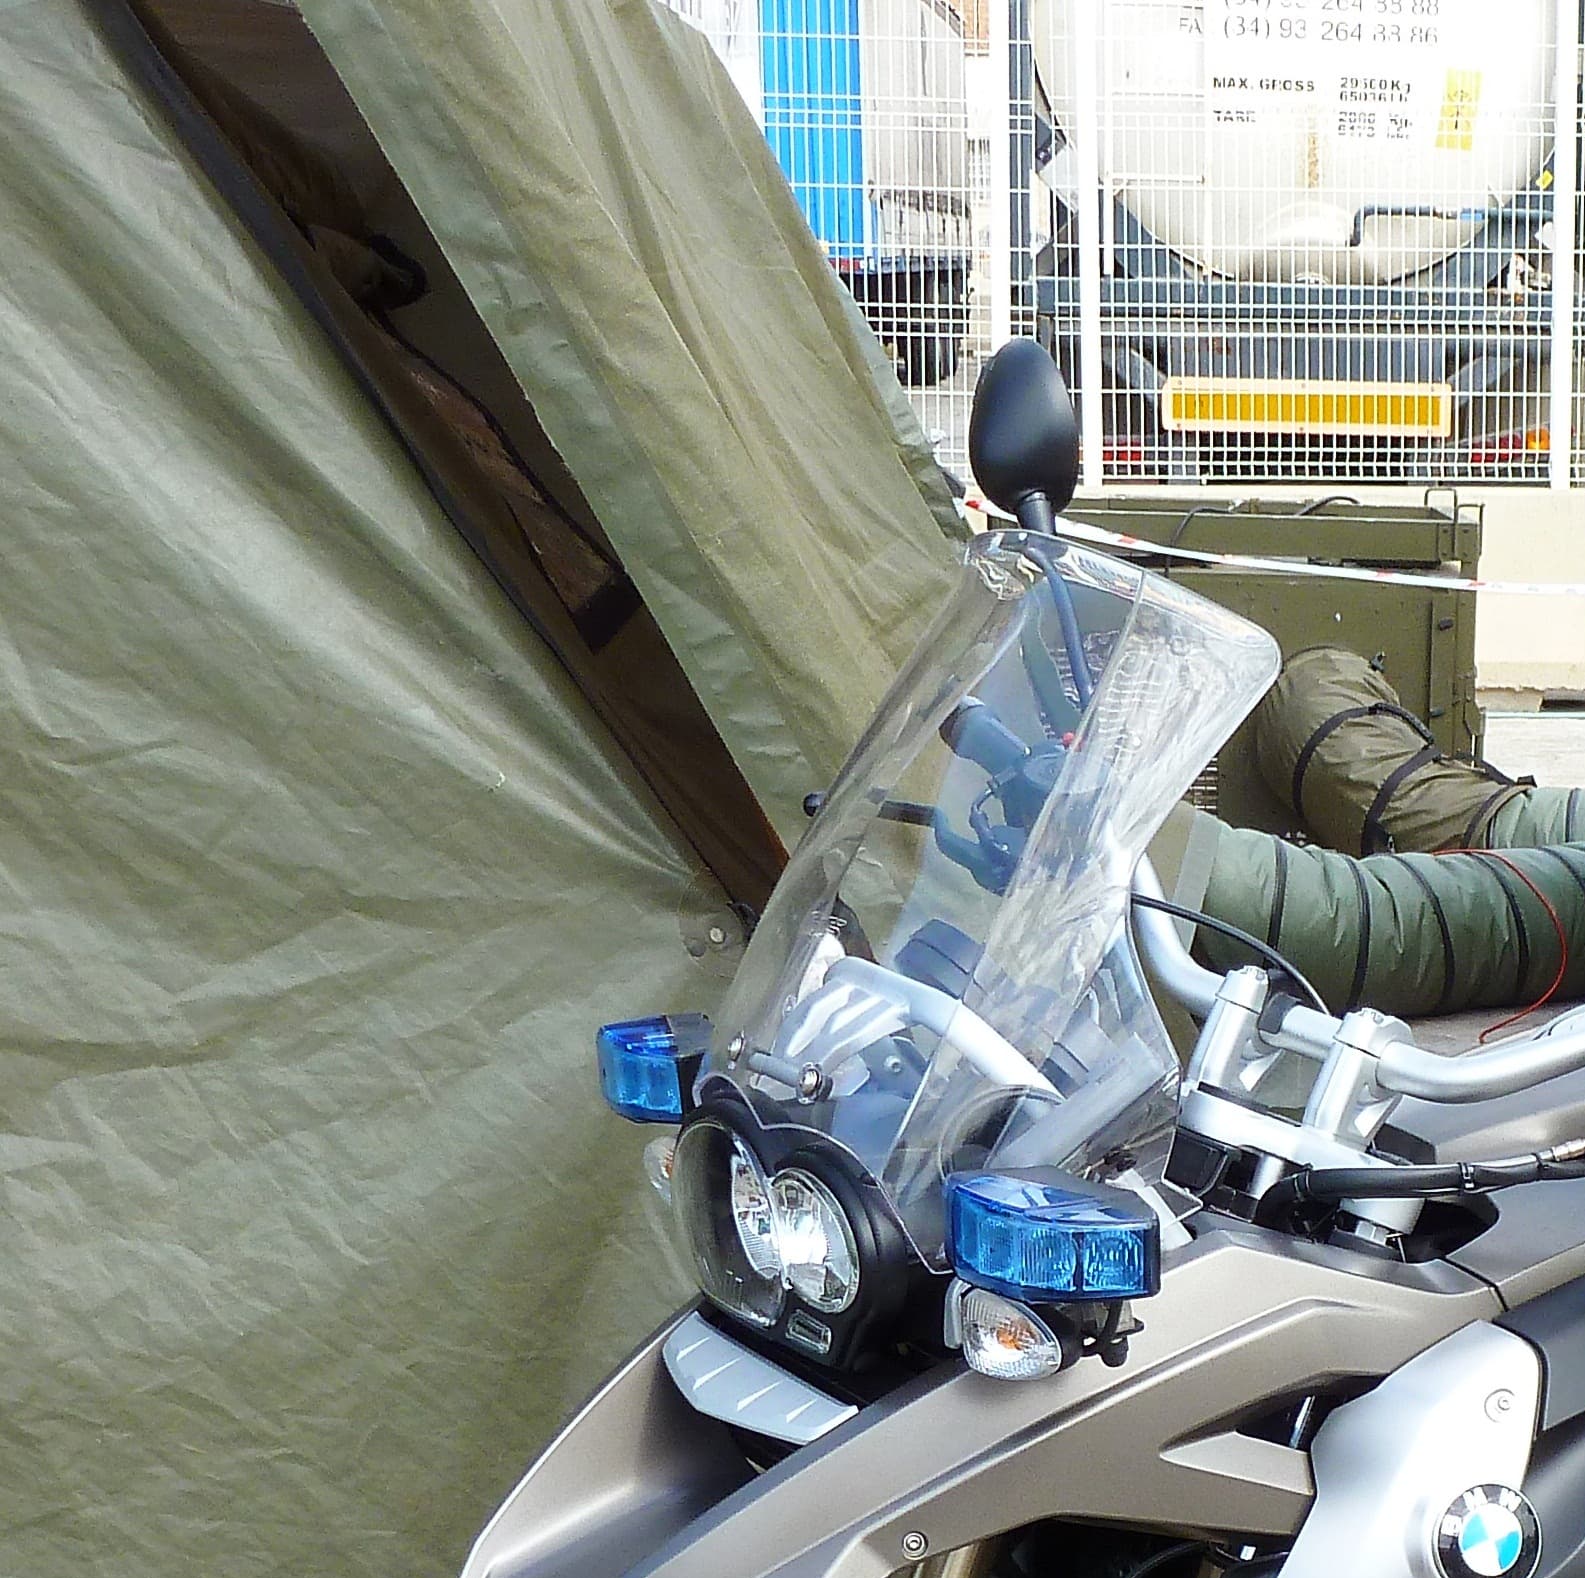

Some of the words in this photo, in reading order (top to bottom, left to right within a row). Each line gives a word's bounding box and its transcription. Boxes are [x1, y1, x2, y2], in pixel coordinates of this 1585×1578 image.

[1224, 16, 1269, 39] (34)
[1280, 18, 1306, 38] 93
[1321, 20, 1361, 42] 264
[1260, 78, 1315, 92] GROSS
[1440, 1485, 1523, 1538] BMW
